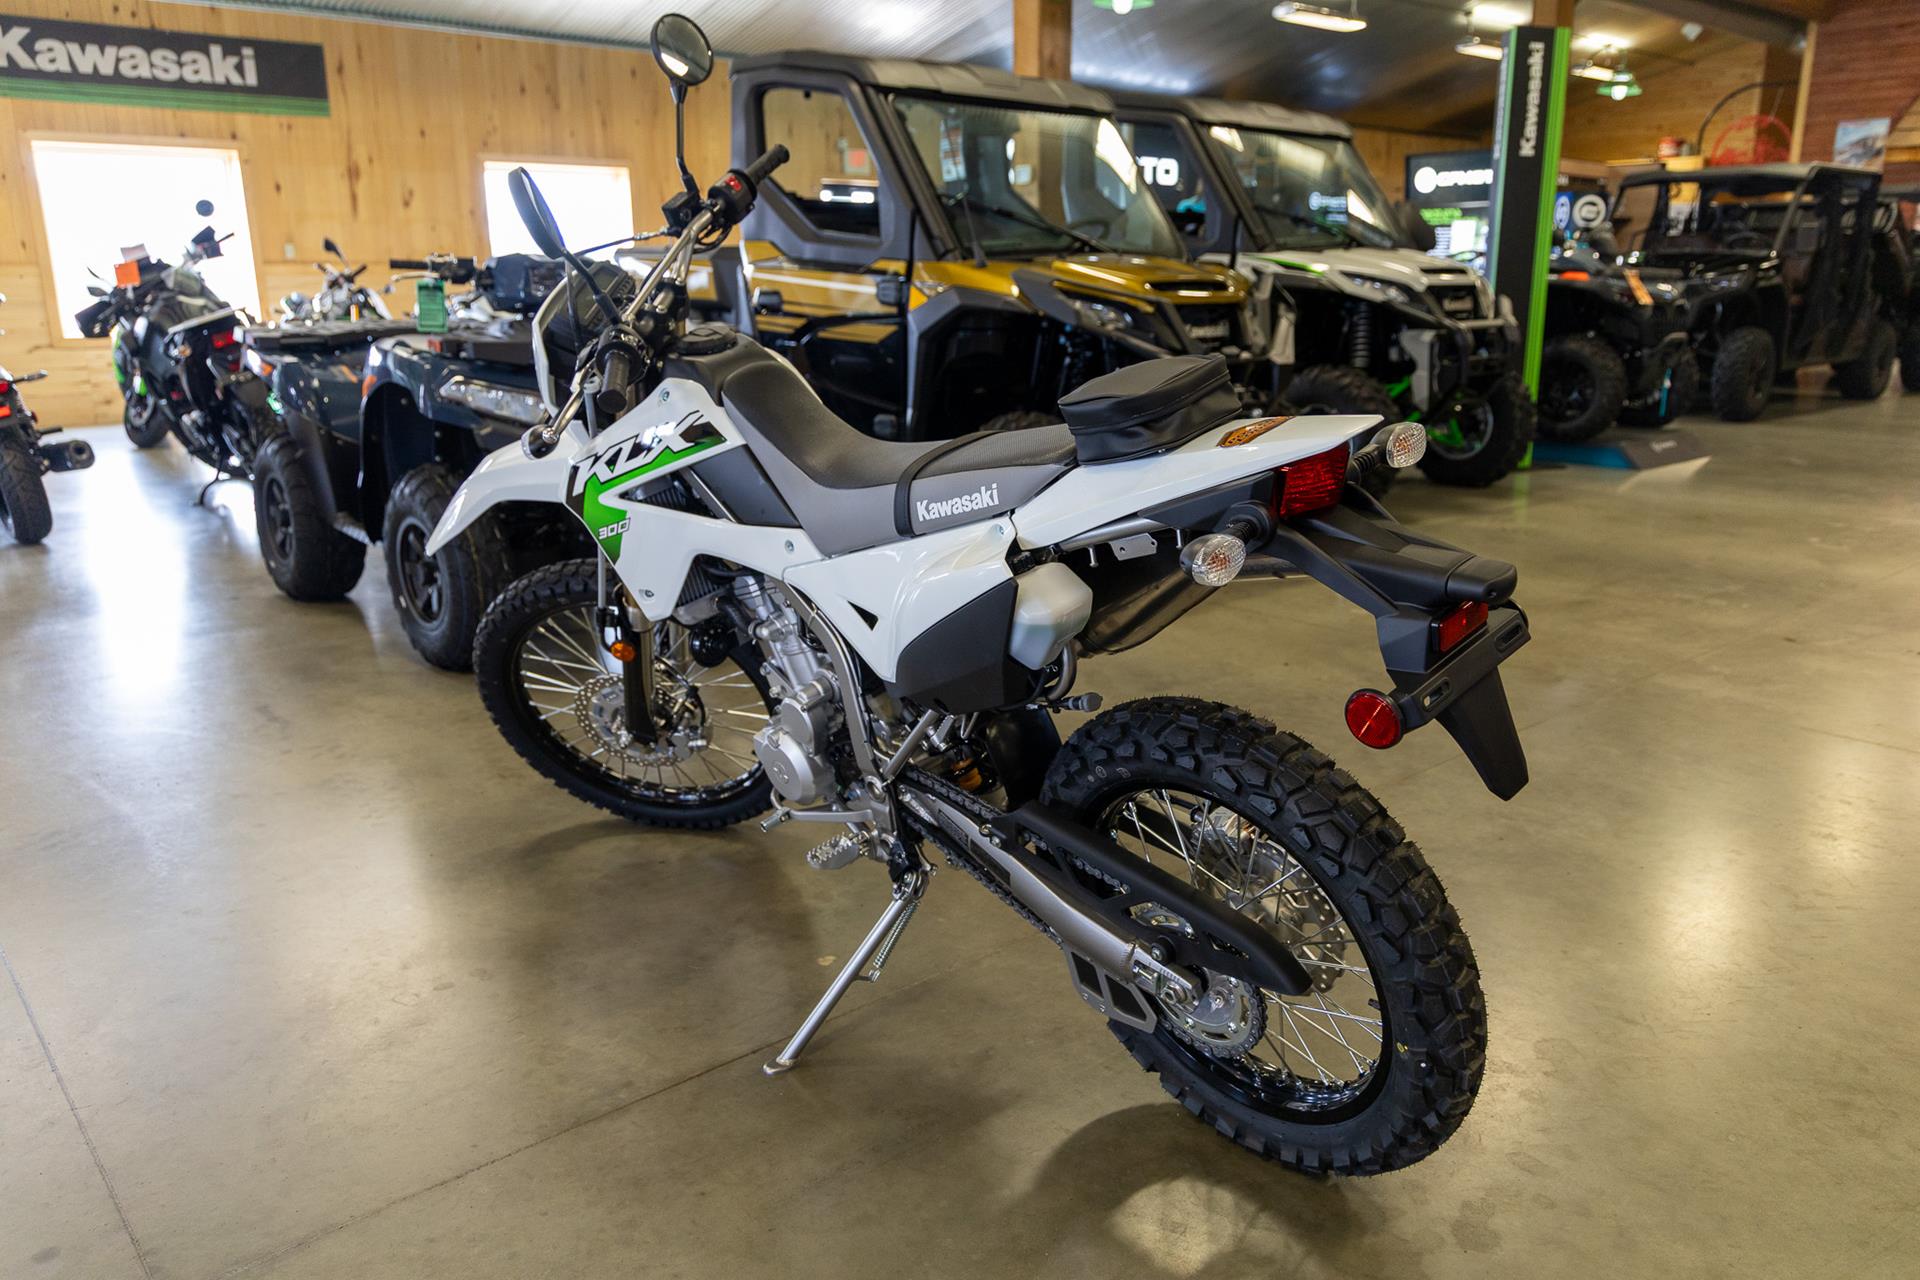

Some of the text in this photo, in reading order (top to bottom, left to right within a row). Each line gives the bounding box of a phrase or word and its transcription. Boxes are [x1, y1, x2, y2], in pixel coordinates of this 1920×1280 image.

[0, 23, 259, 87] Kawasaki
[1518, 41, 1545, 157] Kawasaki
[572, 410, 704, 497] KLX
[598, 517, 631, 540] 300
[916, 482, 999, 522] Kawasaki
